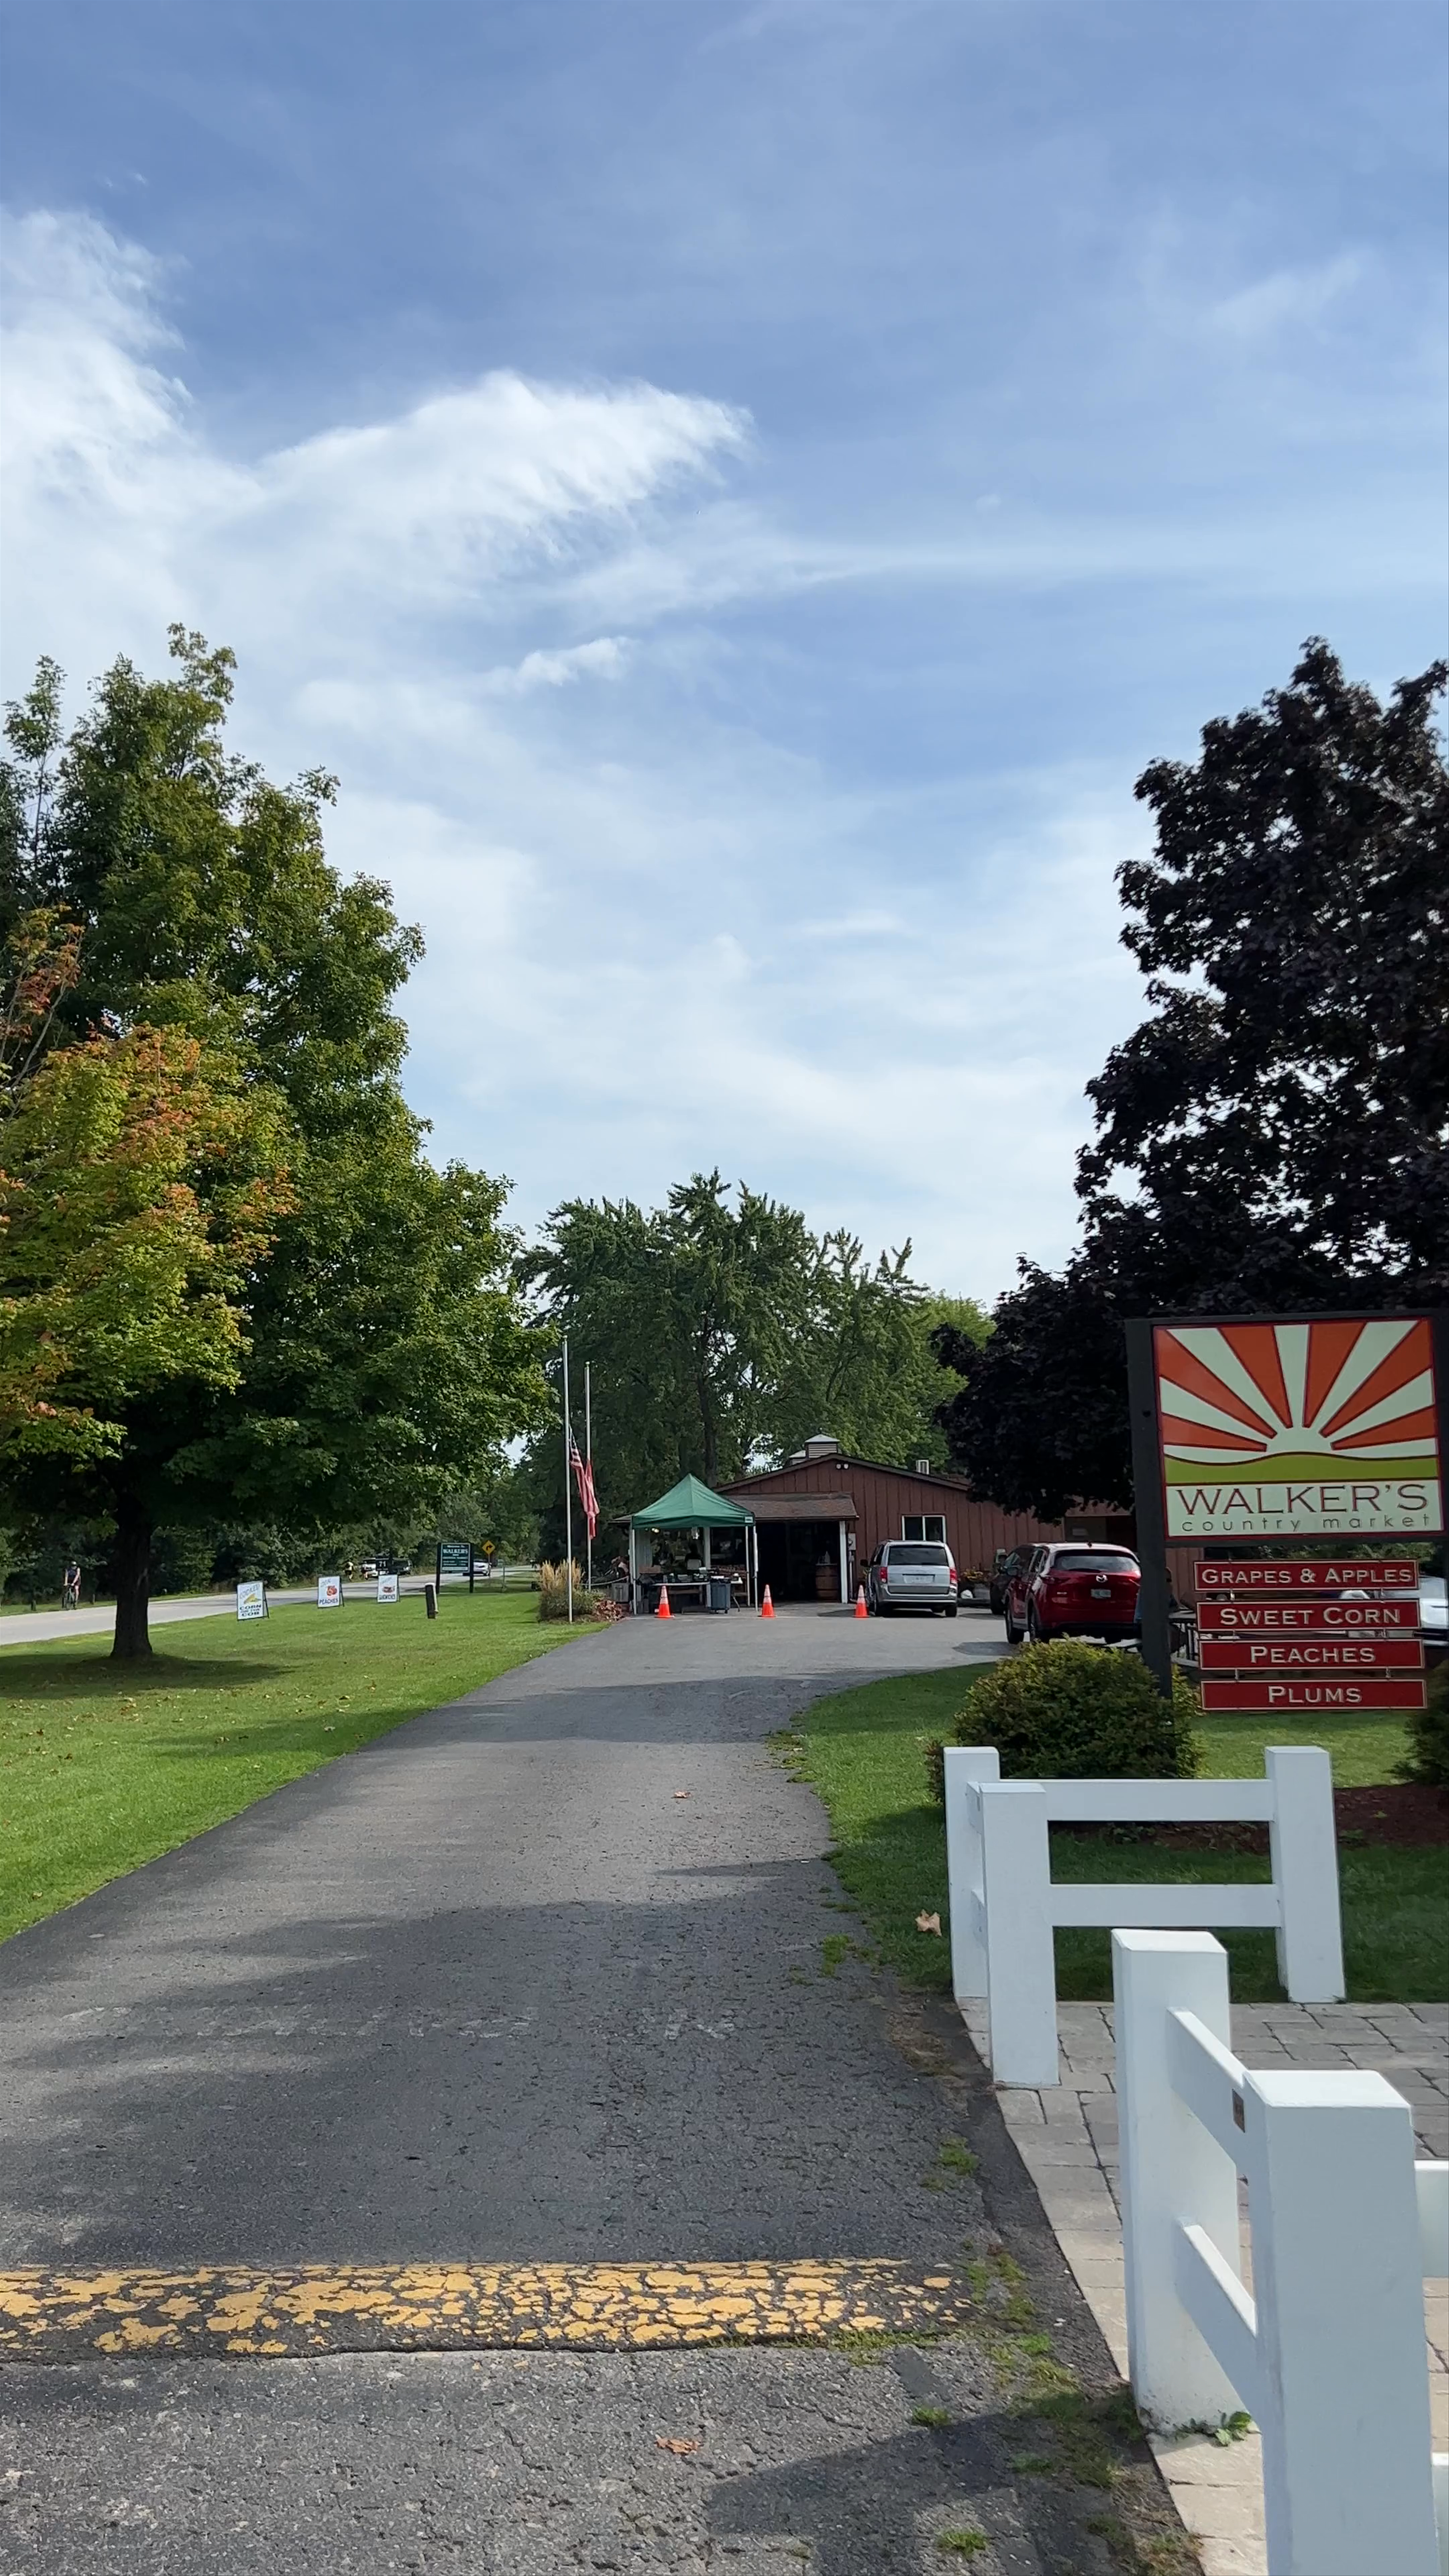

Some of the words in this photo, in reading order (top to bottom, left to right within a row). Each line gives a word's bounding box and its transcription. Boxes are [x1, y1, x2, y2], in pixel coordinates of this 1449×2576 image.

[1175, 1484, 1428, 1515] WALKER'S
[1182, 1518, 1300, 1532] country
[1323, 1513, 1429, 1529] market
[1201, 1569, 1292, 1584] GRAPES
[1300, 1568, 1316, 1583] &
[1324, 1568, 1413, 1583] APPLES
[1220, 1608, 1314, 1625] SWEET
[1323, 1607, 1400, 1624] CORN
[1250, 1646, 1376, 1663] PEACHES
[1268, 1686, 1362, 1703] PLUMS
